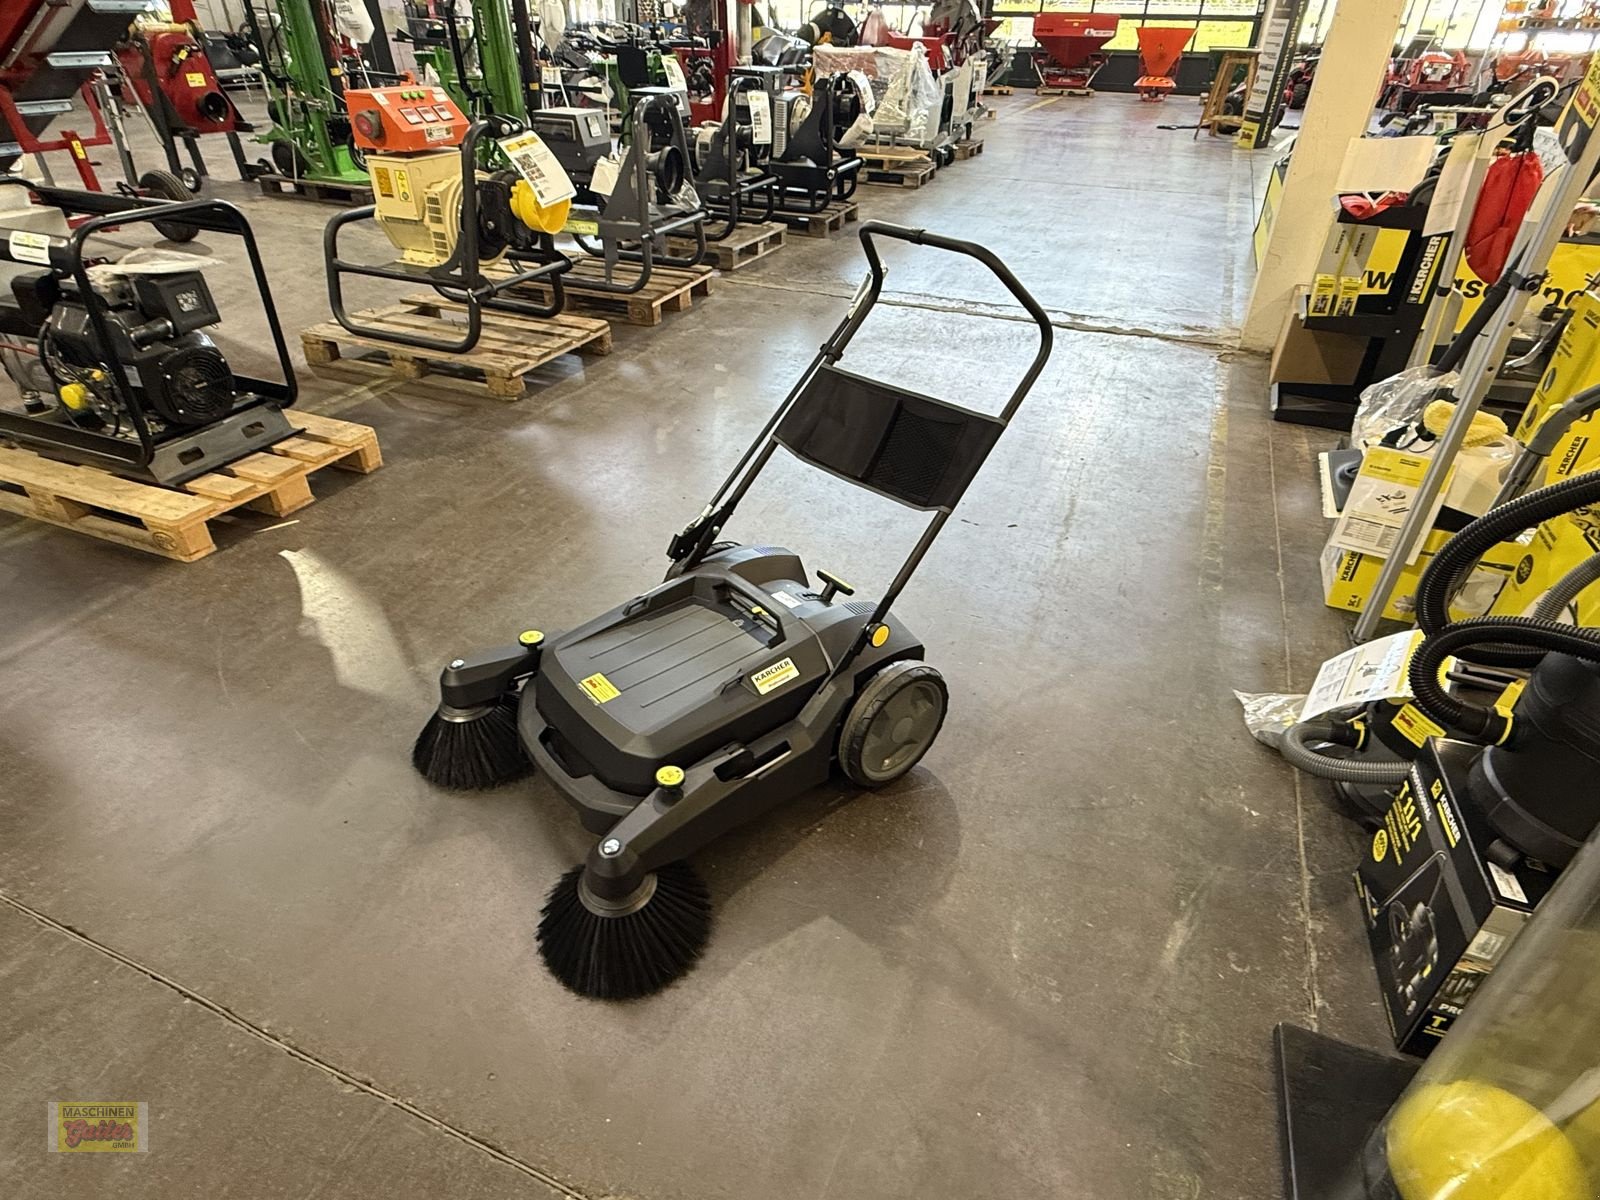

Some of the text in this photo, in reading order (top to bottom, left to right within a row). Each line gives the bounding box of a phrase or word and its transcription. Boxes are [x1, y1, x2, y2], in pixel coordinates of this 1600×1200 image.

[1340, 550, 1358, 582] KÄRCHE
[1399, 780, 1422, 842] T 11/1
